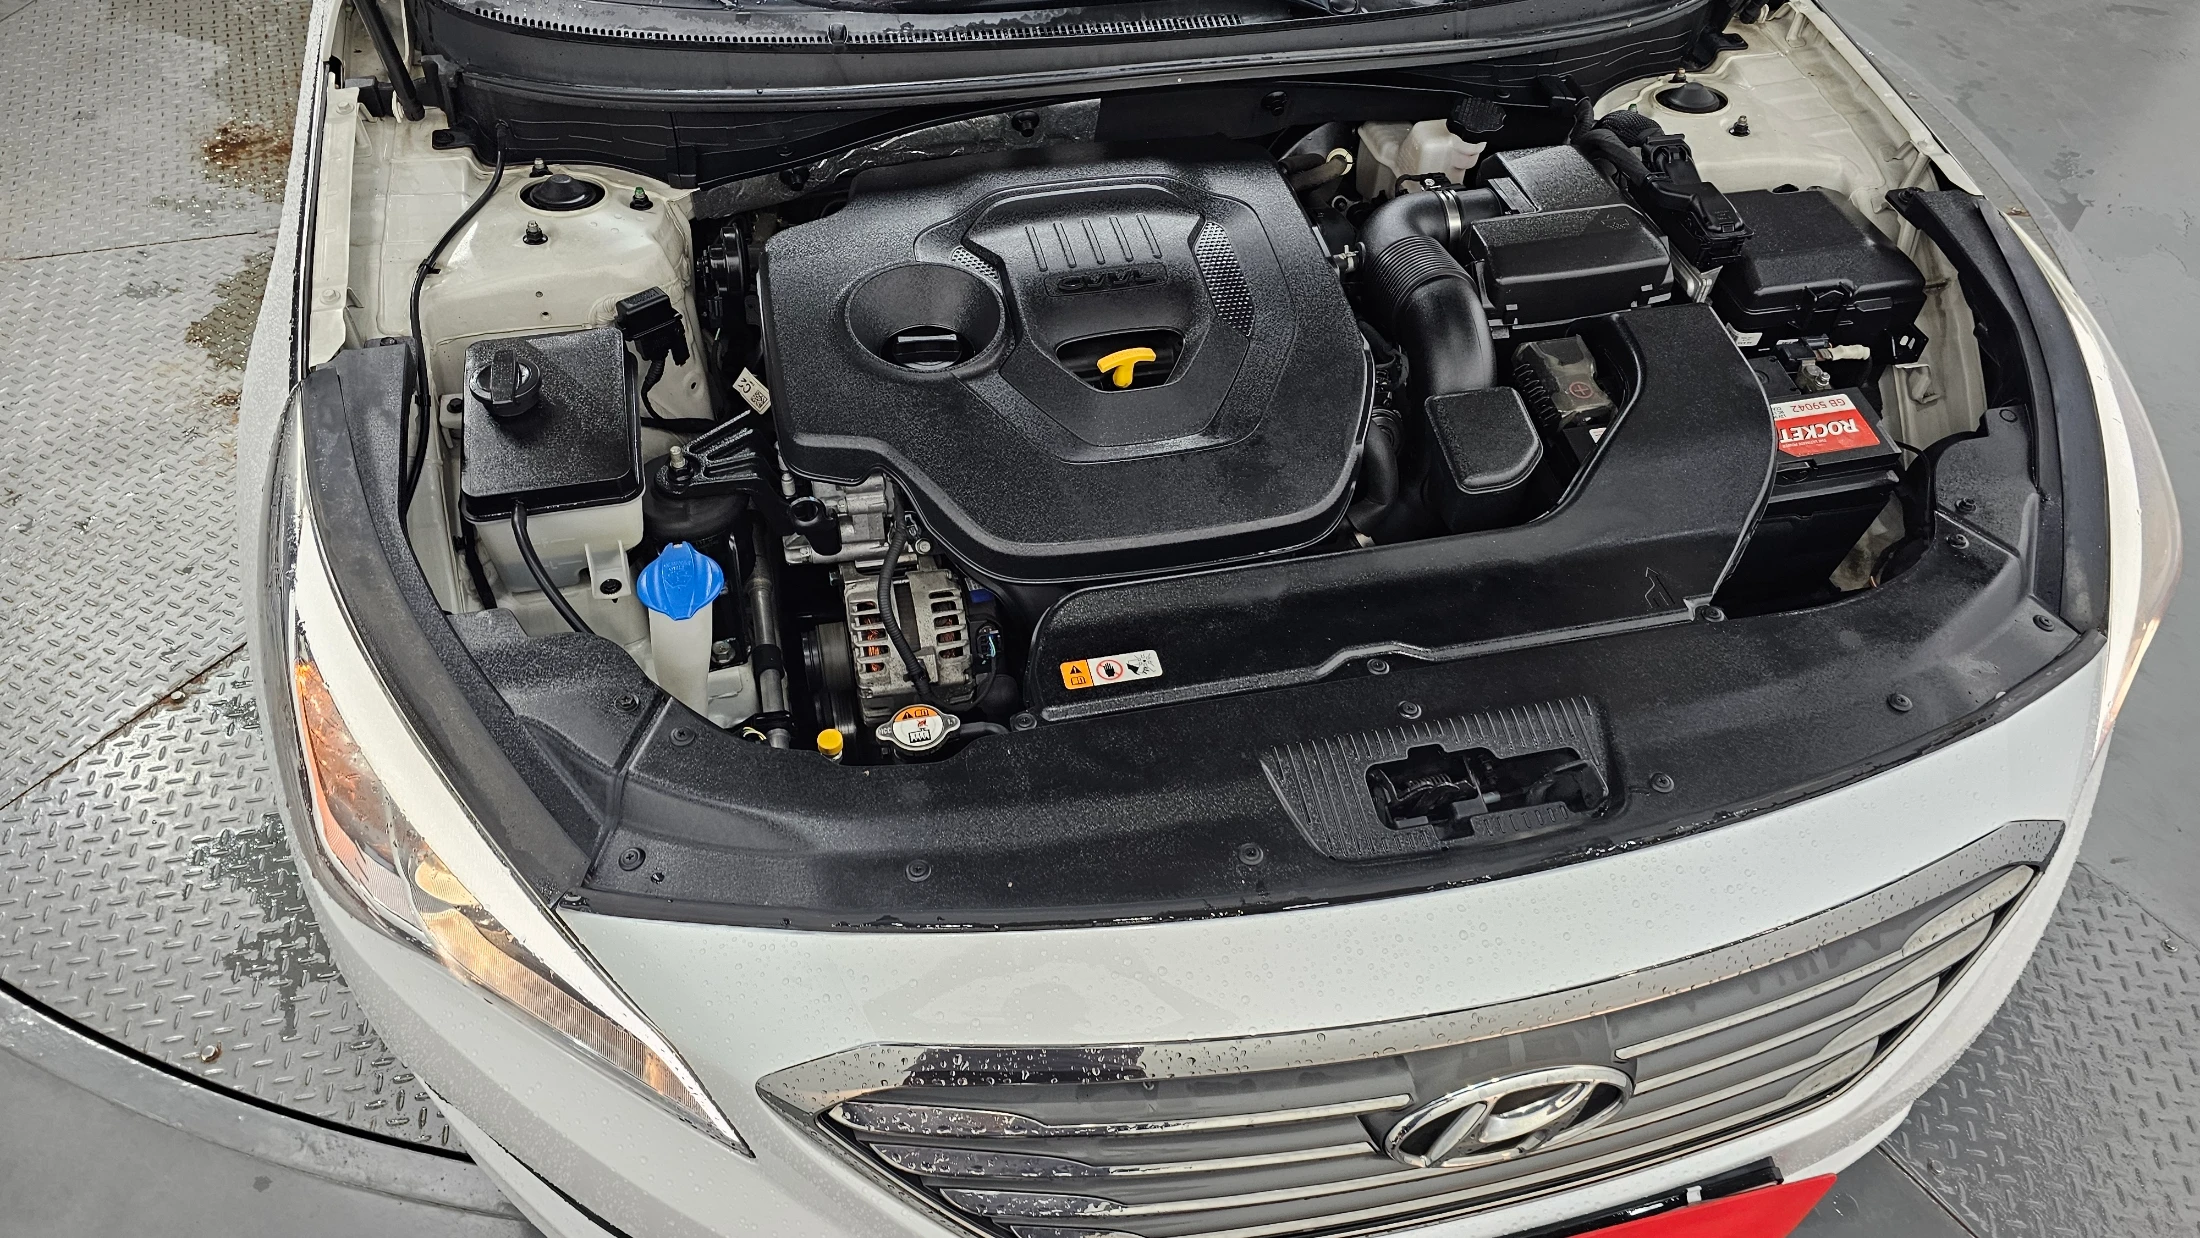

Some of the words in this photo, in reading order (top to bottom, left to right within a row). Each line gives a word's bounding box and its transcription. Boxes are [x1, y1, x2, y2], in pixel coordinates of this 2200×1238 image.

[1790, 401, 1827, 413] 59042
[1829, 398, 1846, 408] GB
[1779, 418, 1859, 443] ROCKET
